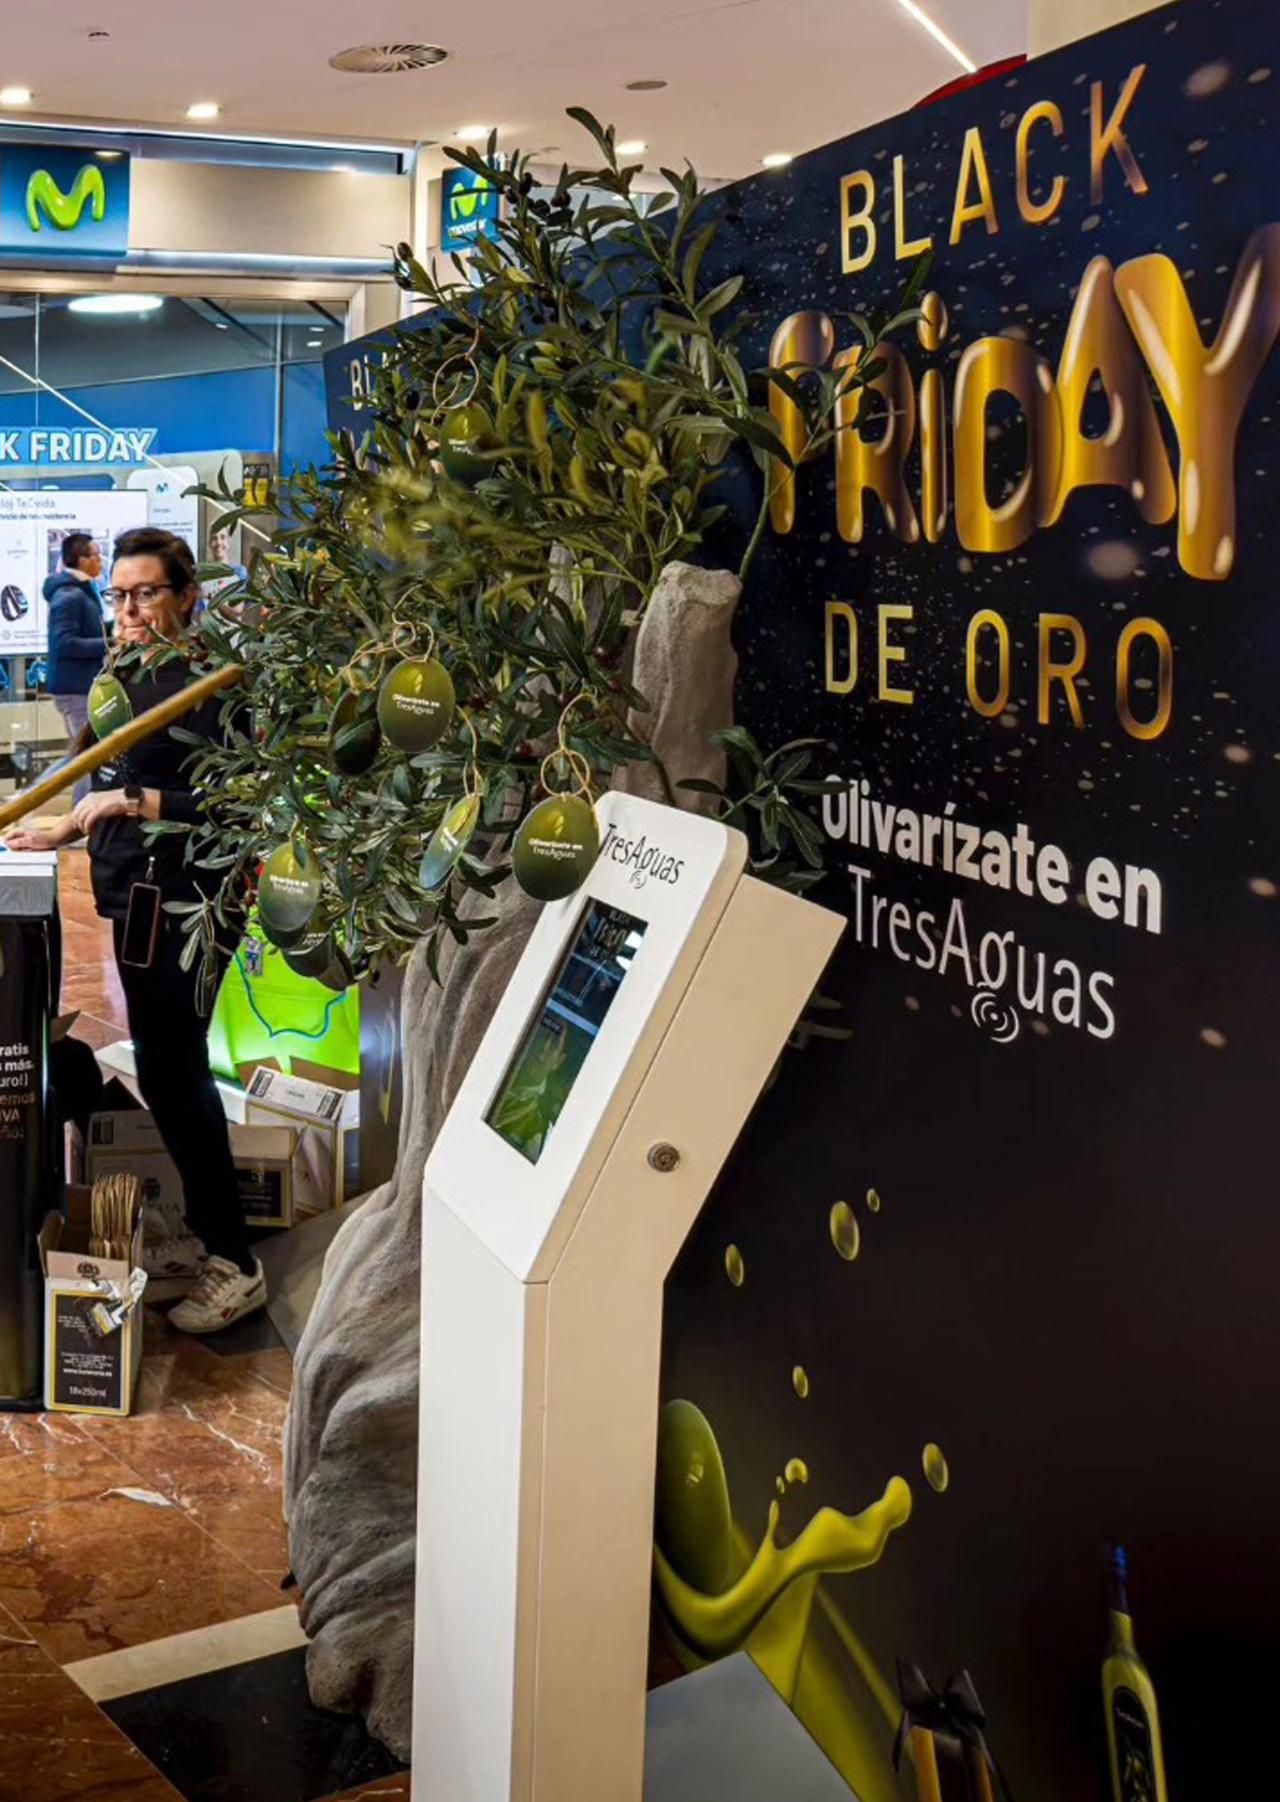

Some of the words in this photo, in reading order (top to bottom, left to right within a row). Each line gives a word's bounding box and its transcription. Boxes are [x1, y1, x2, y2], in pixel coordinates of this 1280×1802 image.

[840, 64, 1148, 274] BLACK
[29, 432, 152, 462] FRIDAY
[824, 601, 914, 704] DE
[966, 609, 1173, 740] ORO
[599, 822, 685, 887] TresAguas
[821, 774, 1072, 904] Olivarízate
[1085, 856, 1162, 935] en
[847, 864, 1115, 1044] TresAguas
